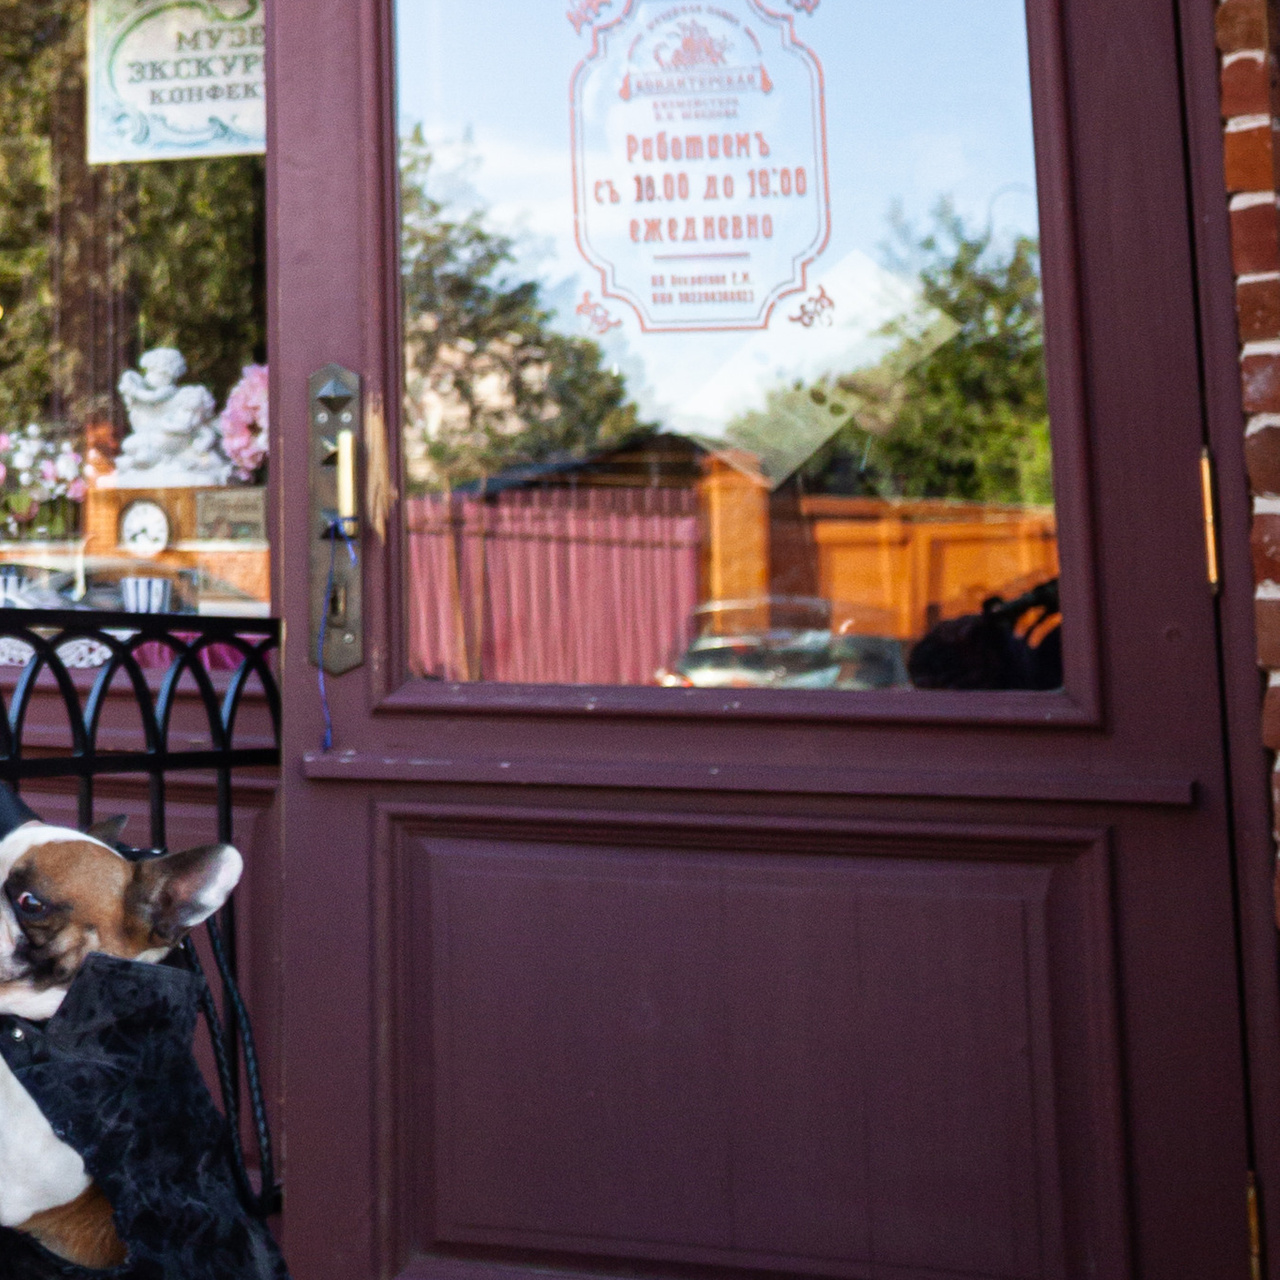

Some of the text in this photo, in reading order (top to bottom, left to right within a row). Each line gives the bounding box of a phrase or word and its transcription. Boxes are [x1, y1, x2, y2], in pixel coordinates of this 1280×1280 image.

[626, 131, 771, 163] Работаемъ
[703, 174, 735, 200] до
[629, 213, 774, 244] ежедневно
